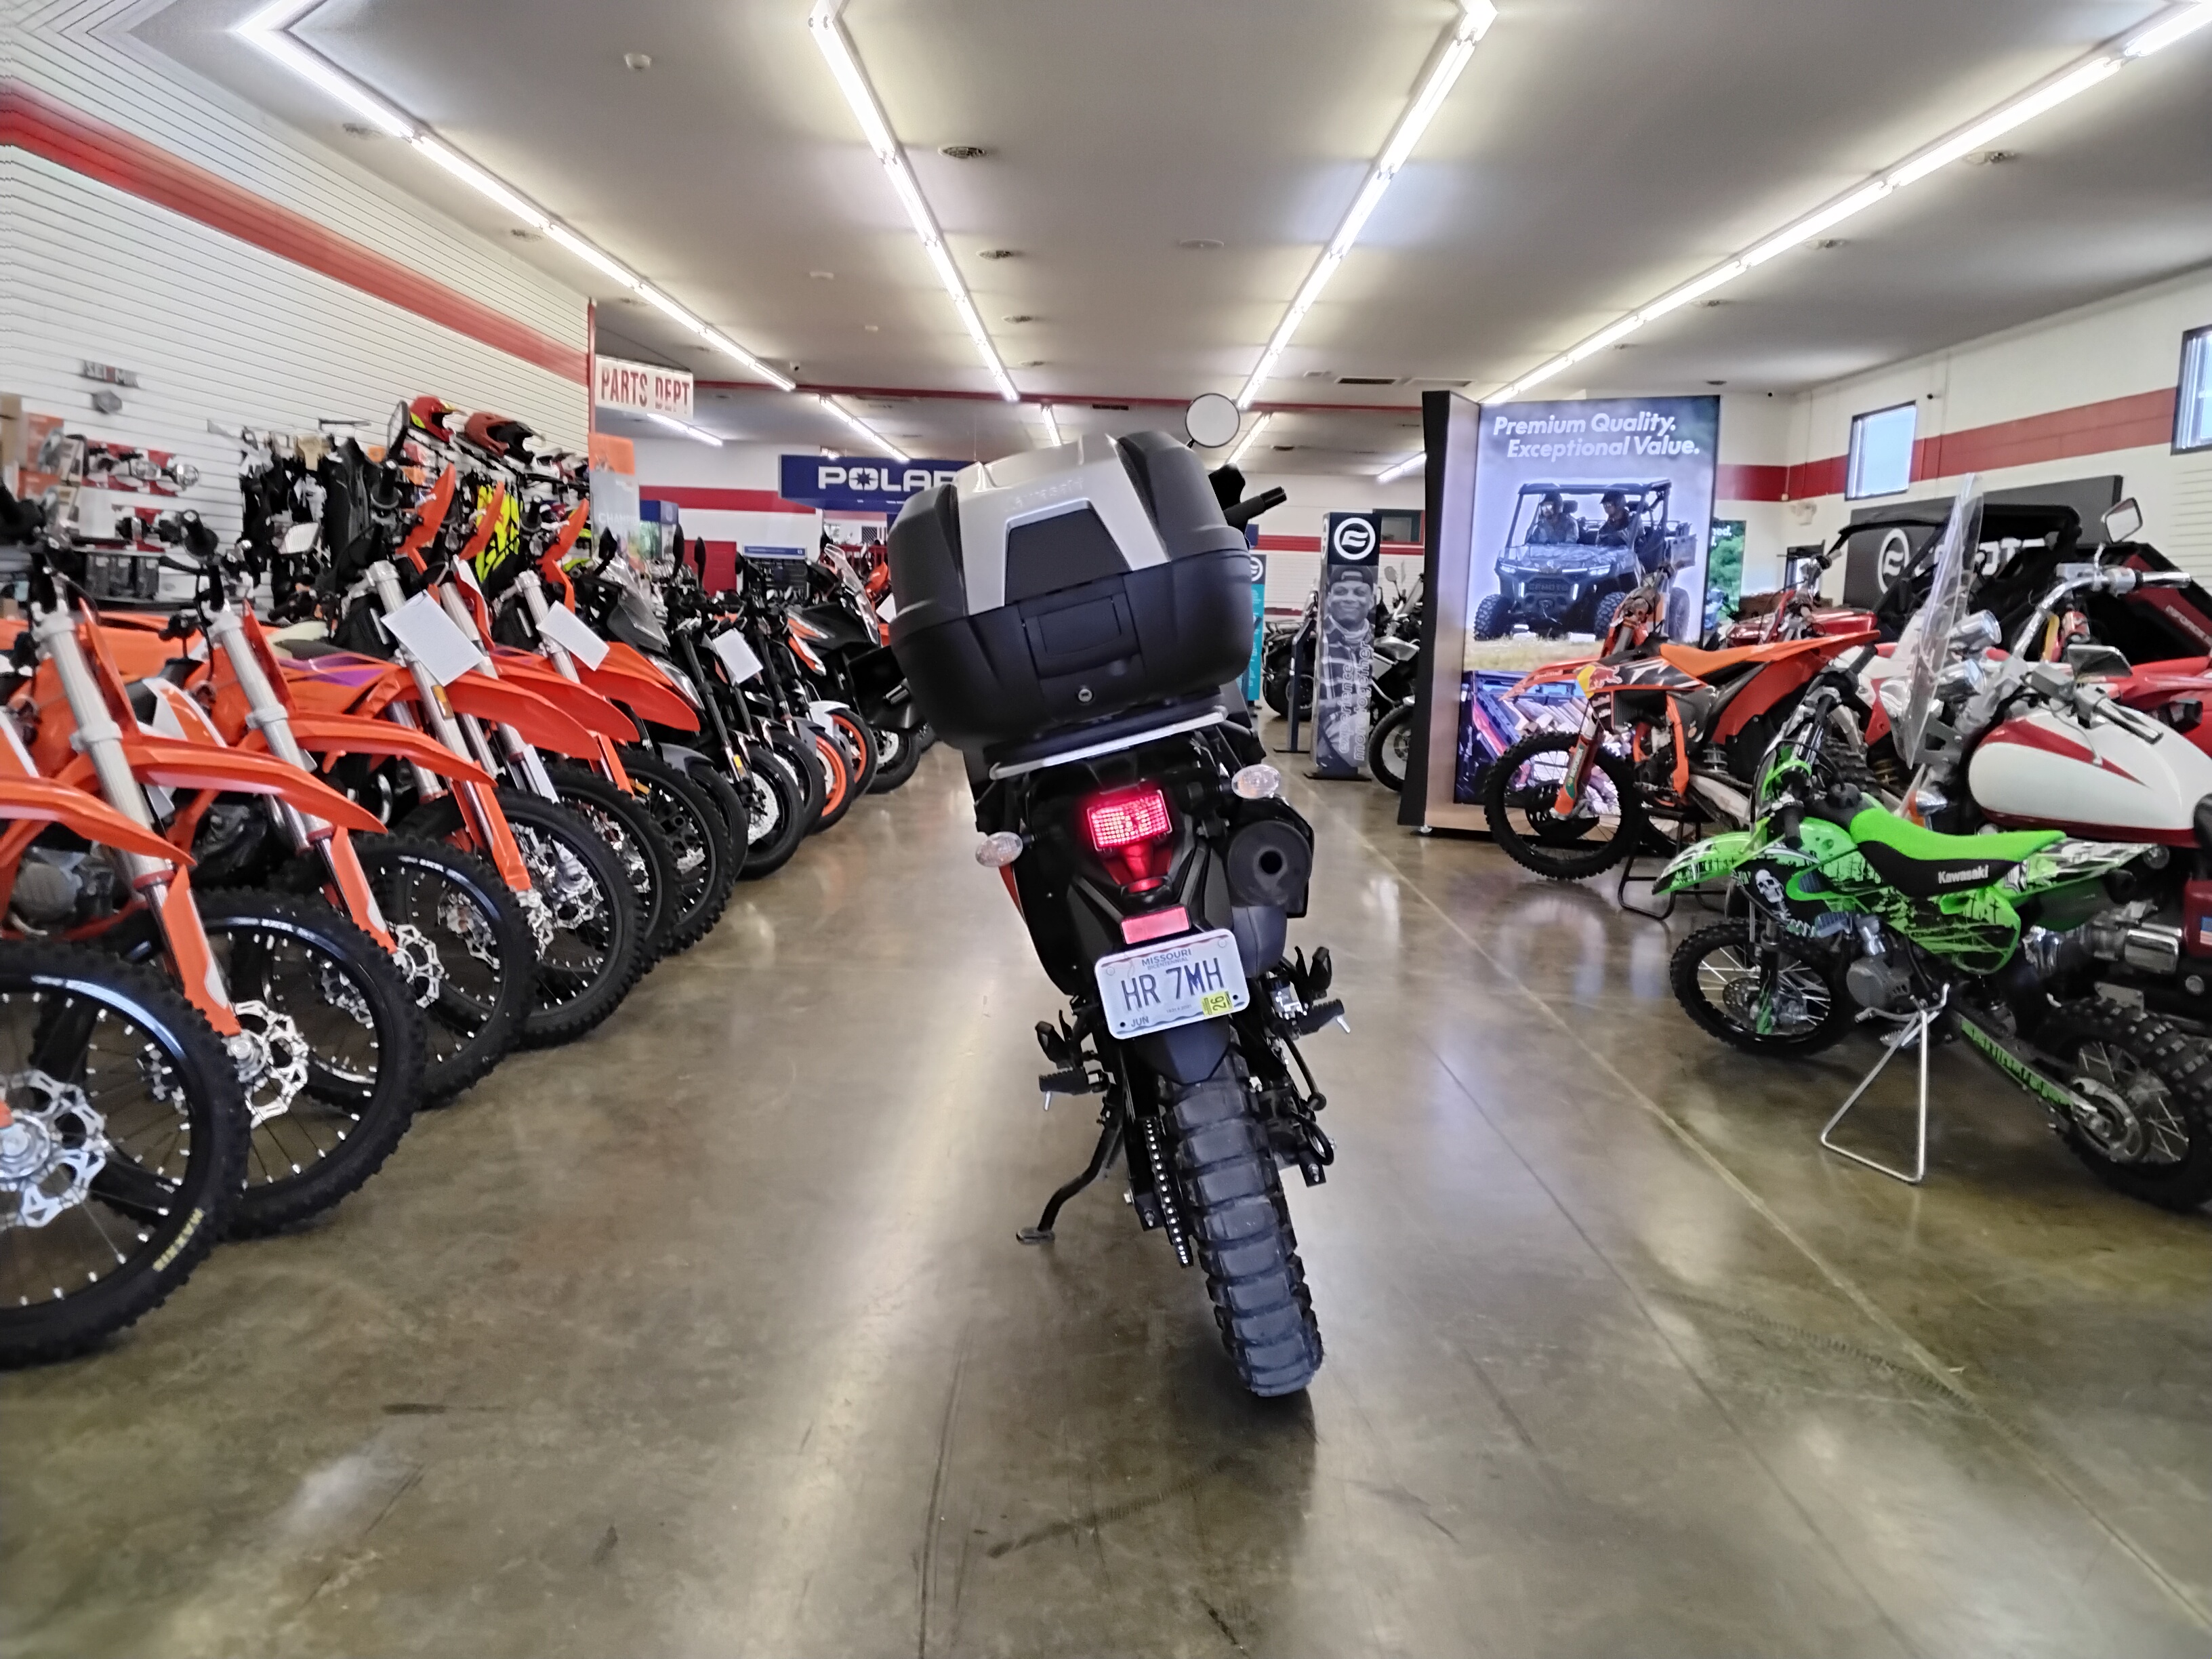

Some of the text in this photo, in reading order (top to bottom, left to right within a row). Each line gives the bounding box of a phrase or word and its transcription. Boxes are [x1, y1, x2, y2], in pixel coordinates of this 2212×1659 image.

[601, 367, 690, 414] PARTS DEPT
[1494, 411, 1676, 436] Premium Quality.
[1507, 435, 1700, 462] Exceptional Value.
[1338, 663, 1354, 754] experience
[1354, 640, 1372, 761] more together
[1938, 864, 1989, 884] Kawasaki
[1142, 948, 1192, 966] MISSOURI
[1147, 957, 1189, 970] BICENTENNIAL
[1121, 958, 1225, 1010] HR 7MH
[1210, 996, 1227, 1011] 26
[1131, 1017, 1149, 1027] JUN
